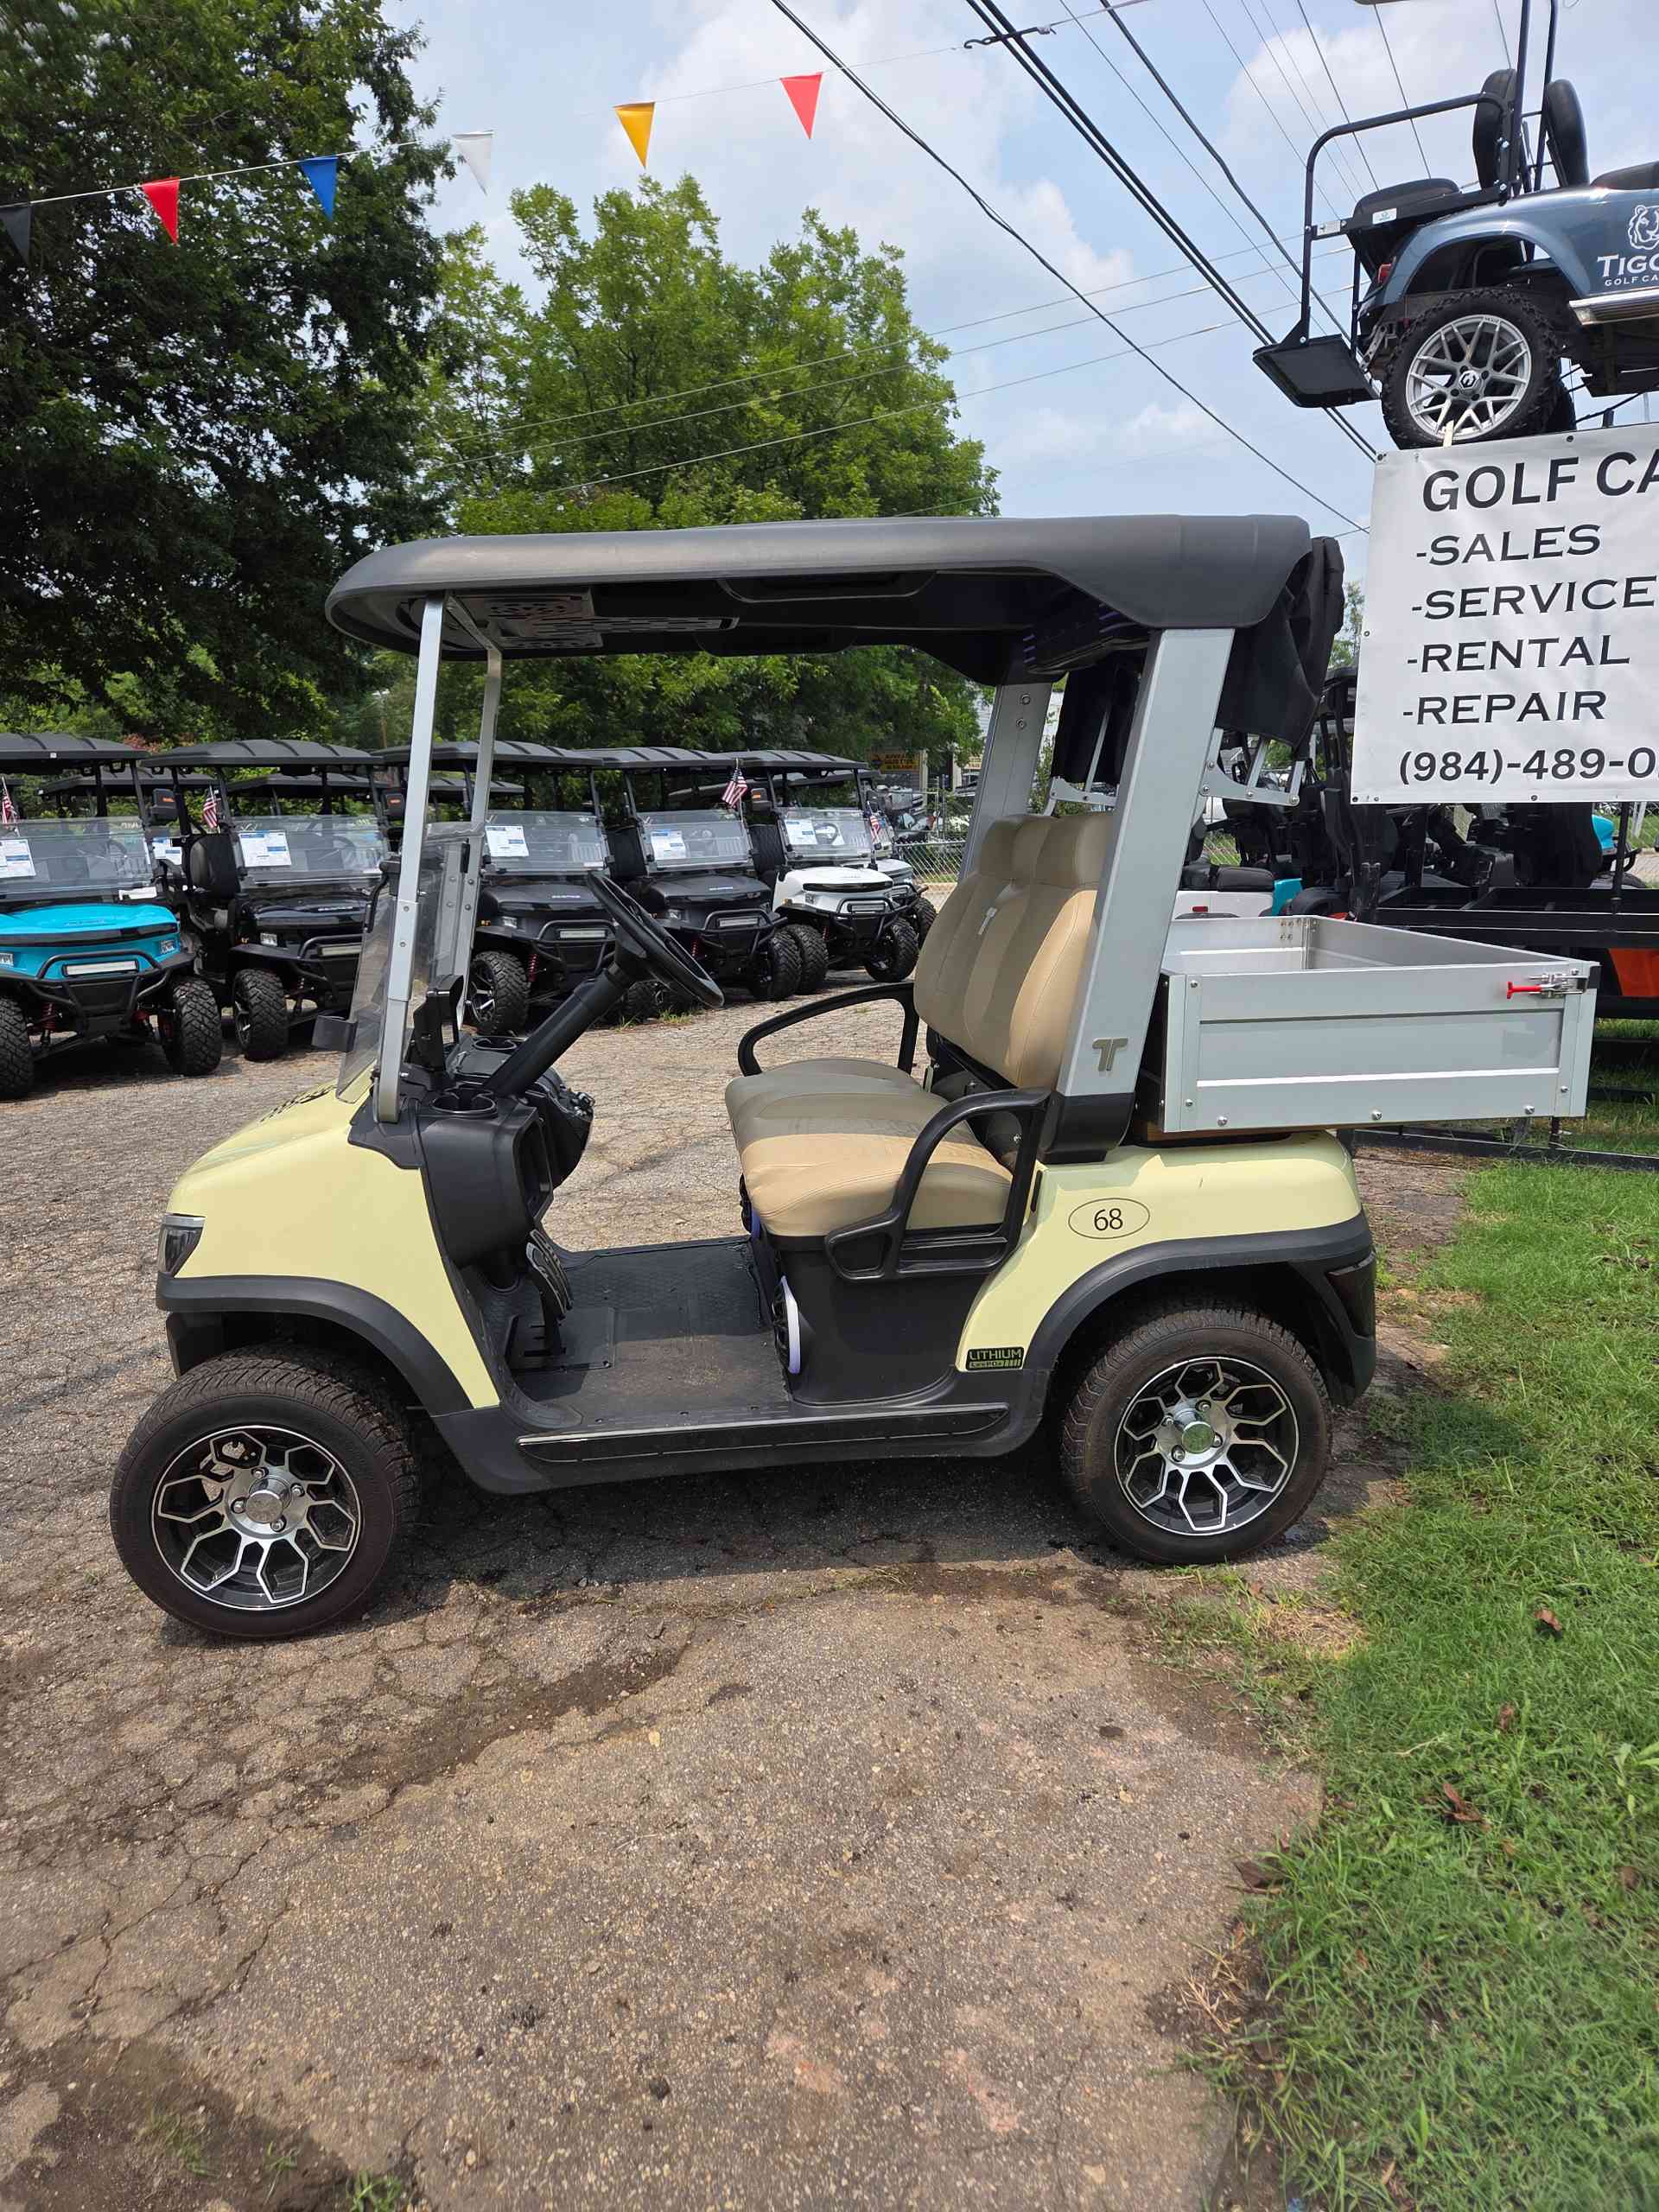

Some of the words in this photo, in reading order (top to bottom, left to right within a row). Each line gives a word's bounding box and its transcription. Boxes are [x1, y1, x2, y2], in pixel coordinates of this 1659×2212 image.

[1605, 276, 1638, 287] GOLF
[1422, 456, 1580, 512] GOLF
[1415, 524, 1600, 567] -SALES
[1411, 575, 1657, 620] -SERVICE
[1406, 634, 1630, 674] -RENTAL
[1402, 690, 1606, 725] -REPAIR
[1400, 747, 1659, 785] (984)-489-0
[1094, 1208, 1123, 1231] 68
[969, 1349, 1021, 1361] LITHIUM
